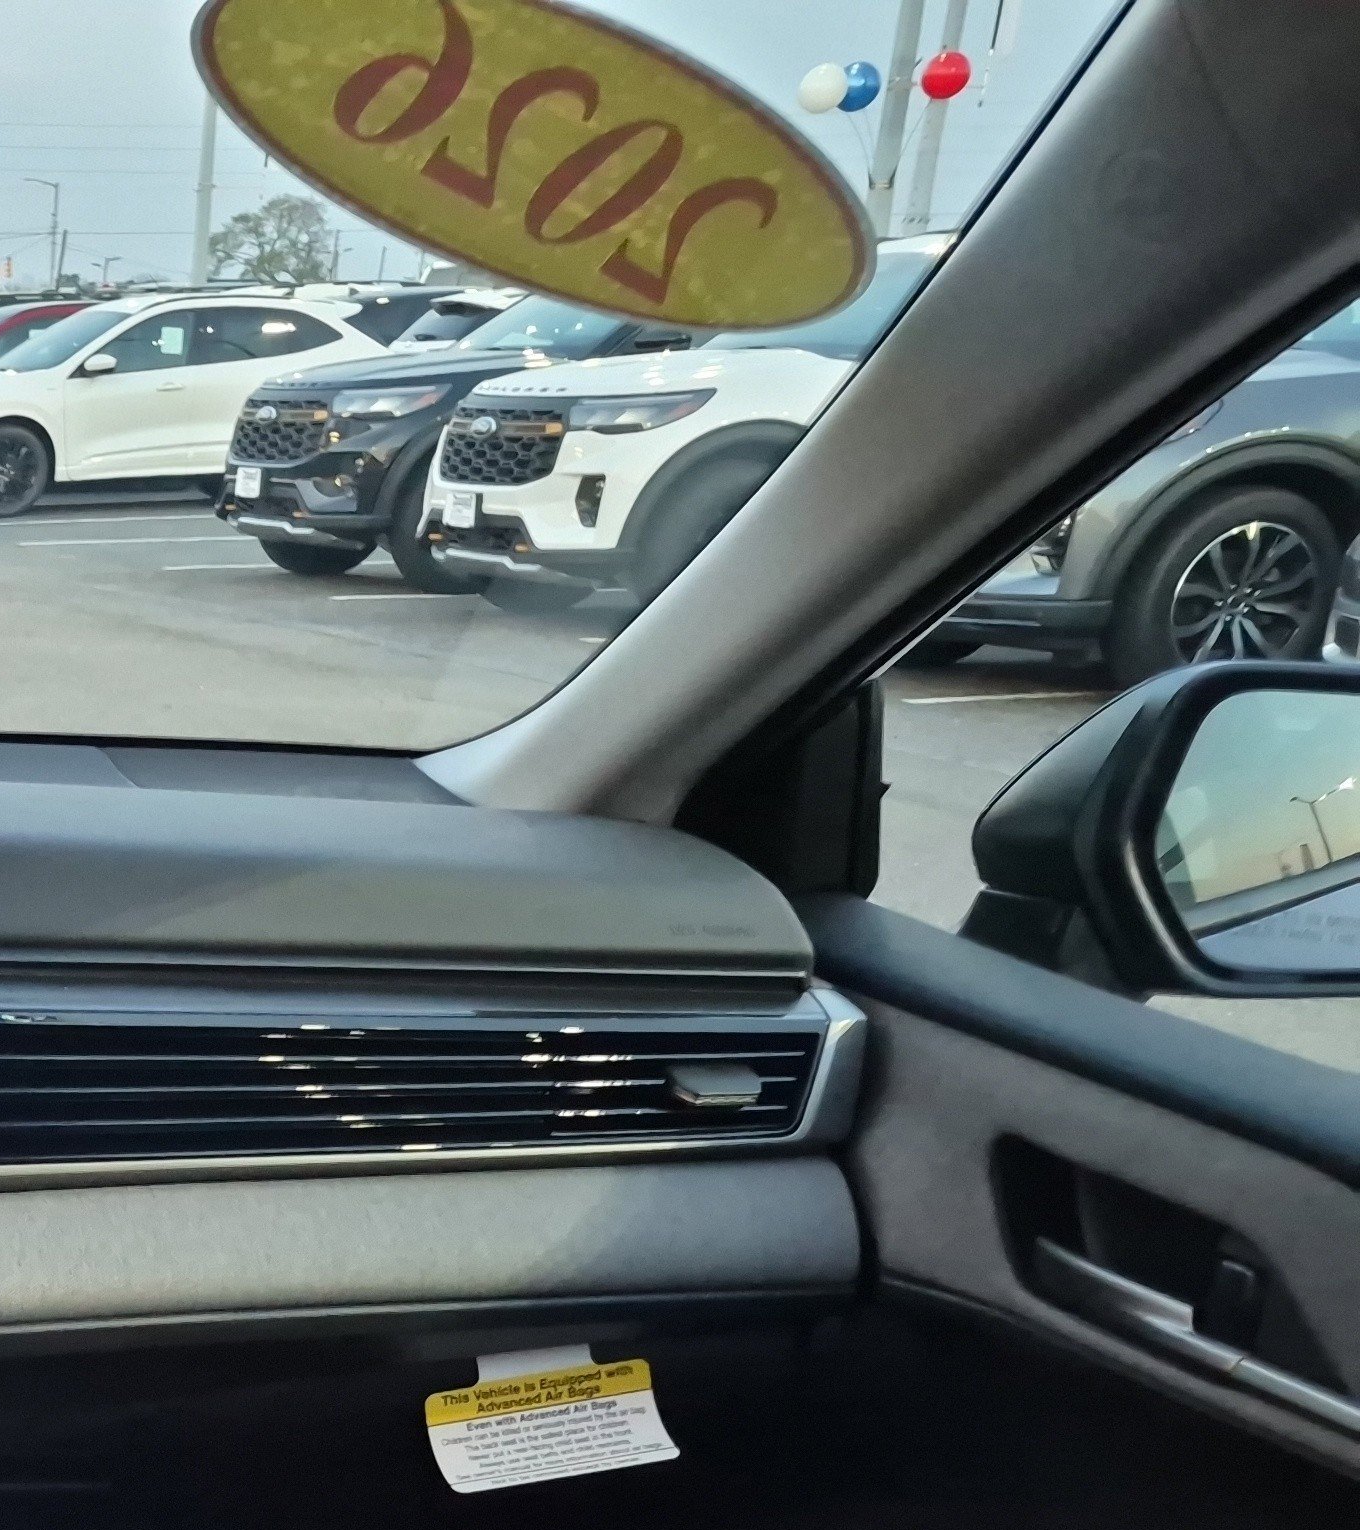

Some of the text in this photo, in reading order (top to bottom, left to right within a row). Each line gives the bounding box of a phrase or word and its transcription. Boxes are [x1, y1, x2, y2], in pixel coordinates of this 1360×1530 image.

[441, 1394, 470, 1407] This
[473, 1384, 521, 1401] Vehicle
[539, 1370, 602, 1392] Equipped
[475, 1384, 602, 1415] Advanced Air Bags
[520, 1405, 572, 1422] Advanced
